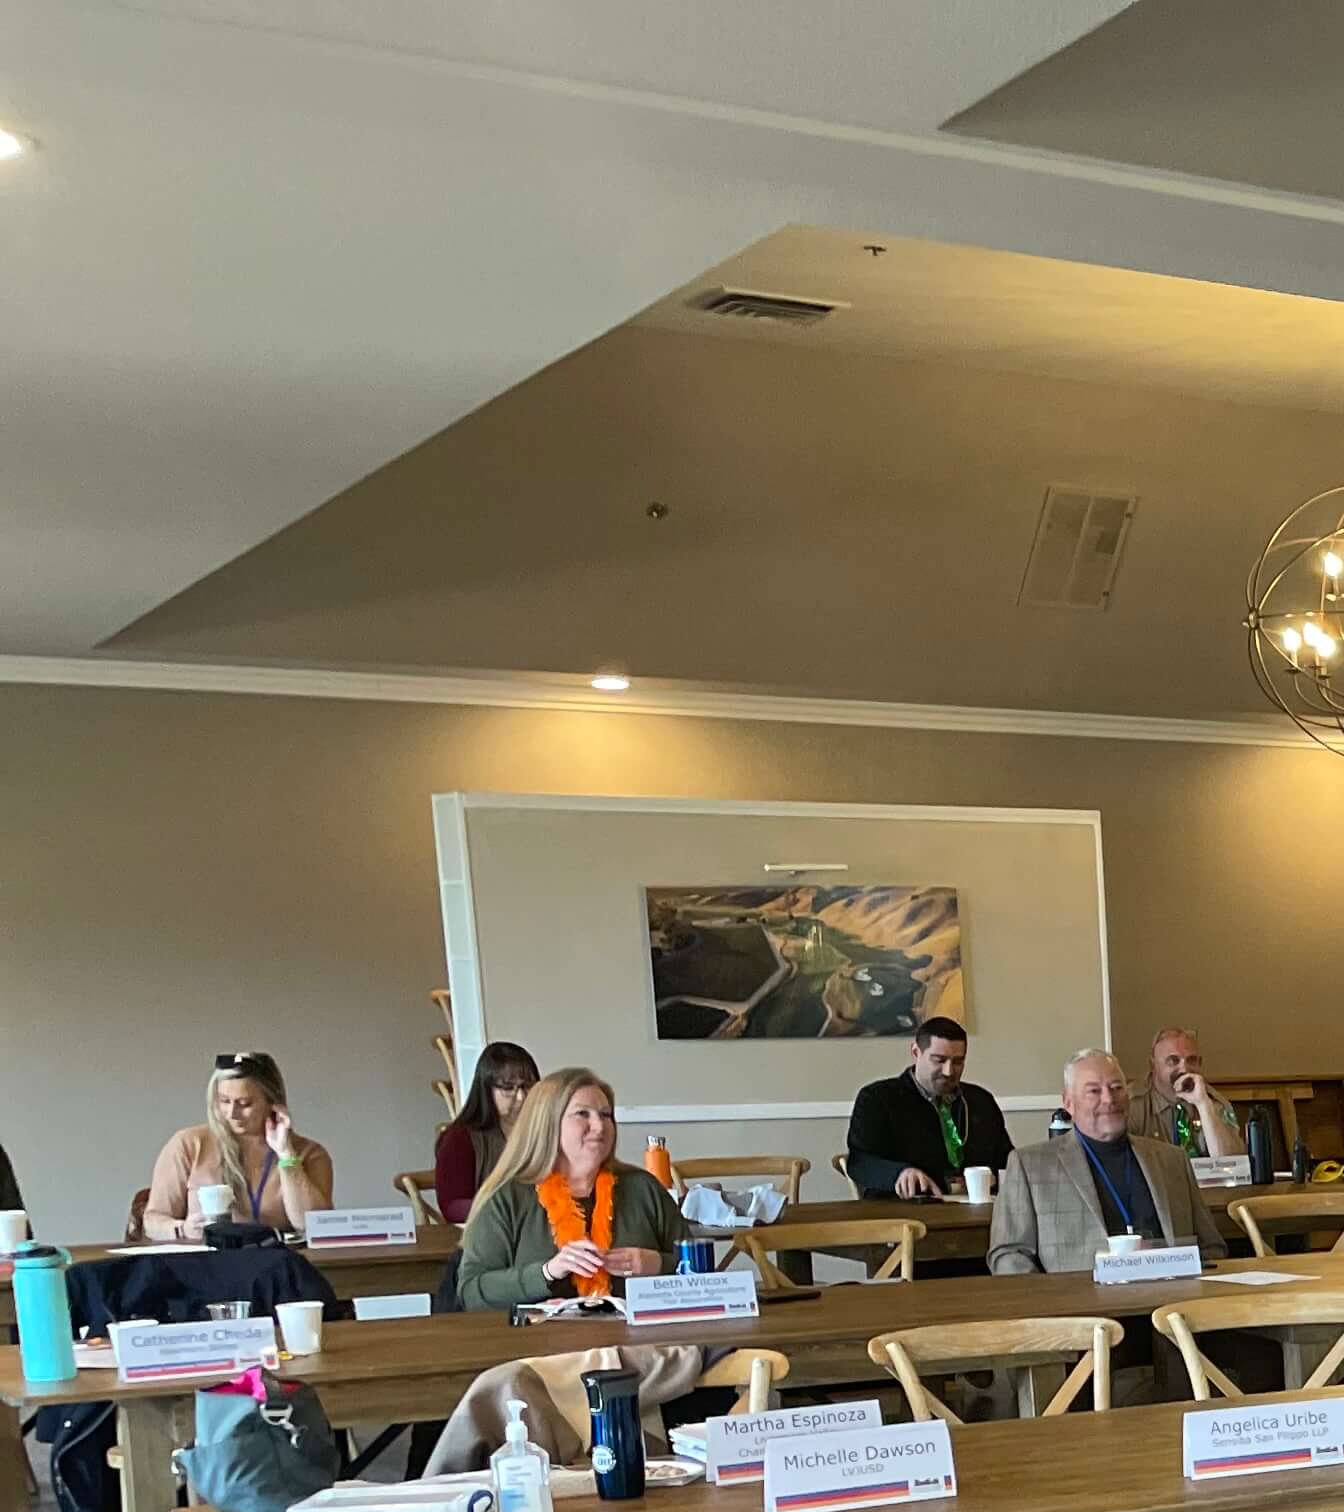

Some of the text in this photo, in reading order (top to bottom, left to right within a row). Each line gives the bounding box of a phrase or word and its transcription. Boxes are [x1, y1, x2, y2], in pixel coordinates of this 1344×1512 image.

[1103, 1253, 1194, 1268] Michael Wilkinson
[653, 1276, 728, 1290] Beth Wilcox
[131, 1331, 208, 1348] Catherine
[723, 1408, 866, 1435] Martha Espinoza
[1210, 1410, 1328, 1437] Angelica Uribe
[1254, 1434, 1274, 1443] San
[1312, 1427, 1329, 1437] LLP
[784, 1440, 936, 1471] Michelle Dawson
